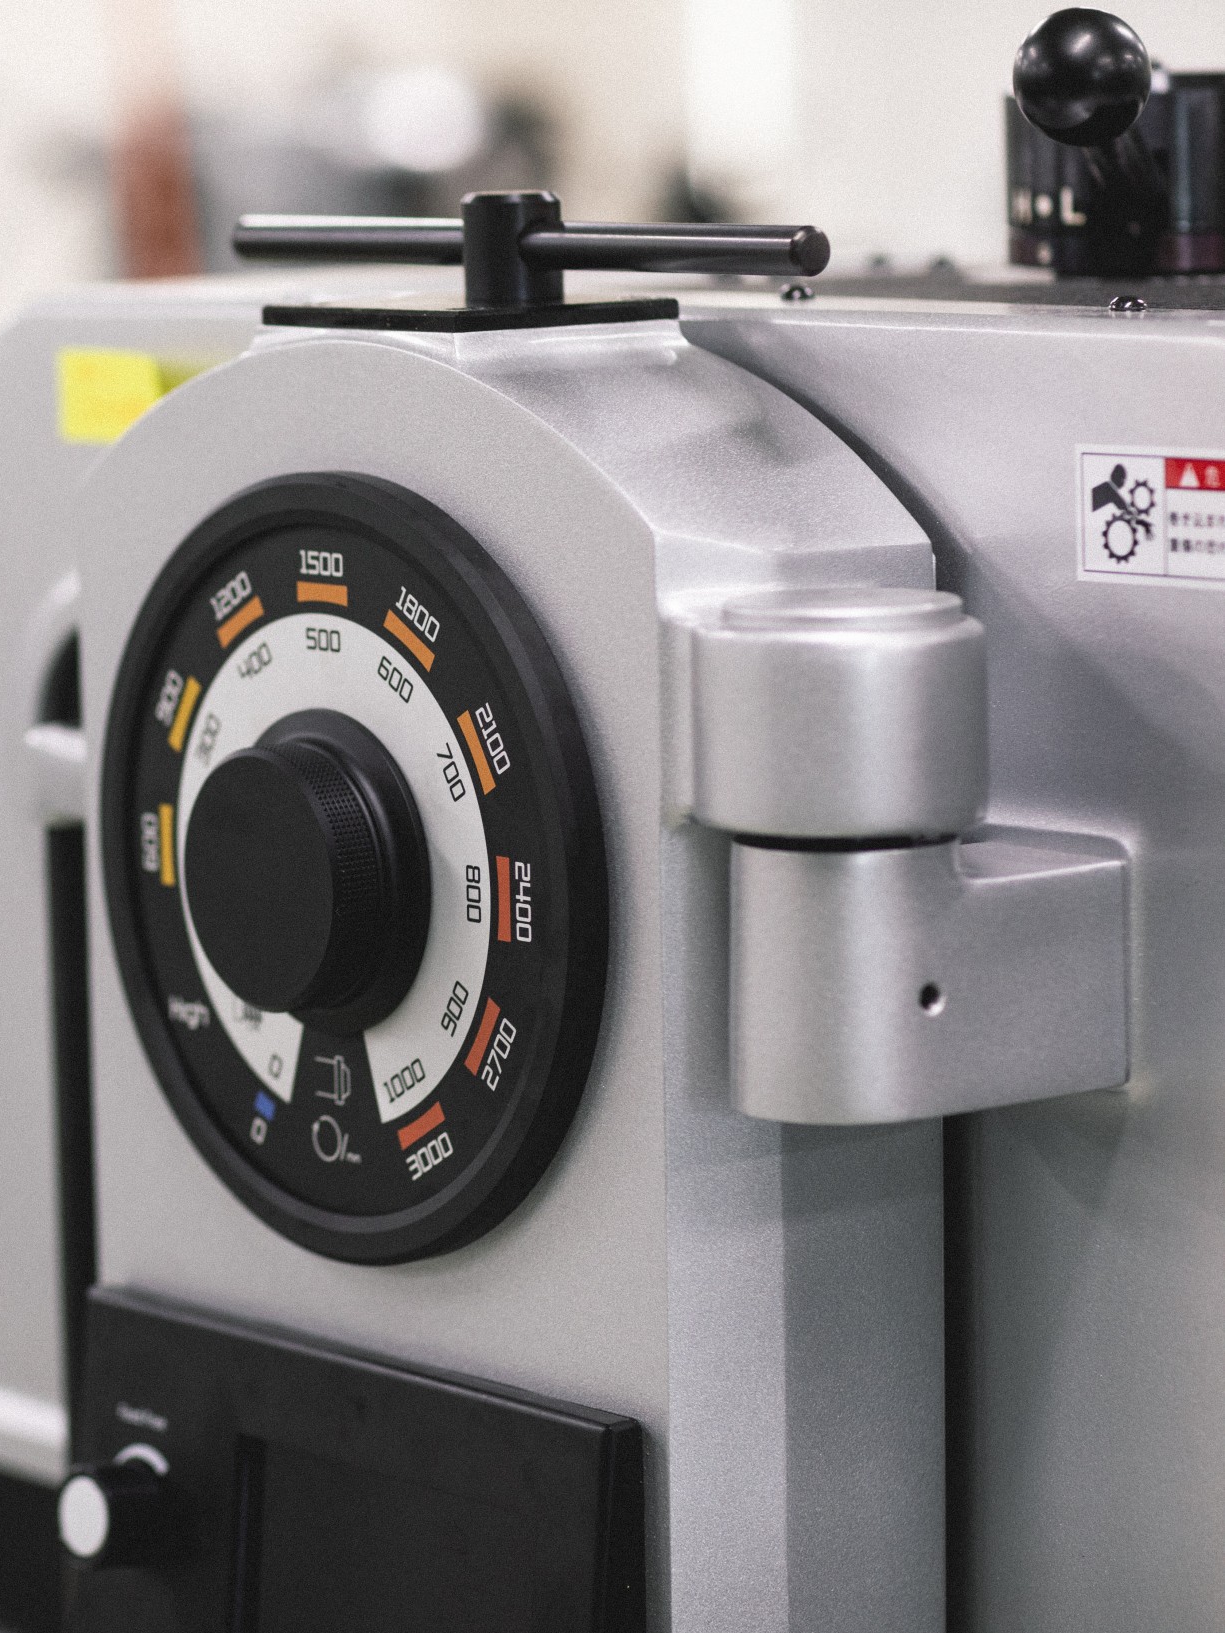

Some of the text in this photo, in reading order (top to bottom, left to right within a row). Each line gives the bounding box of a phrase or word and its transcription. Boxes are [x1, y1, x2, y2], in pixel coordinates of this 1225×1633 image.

[298, 549, 344, 578] 1500
[209, 570, 253, 622] 1200
[395, 585, 441, 643] 1800
[236, 641, 273, 680] 400
[305, 626, 342, 653] 500
[376, 655, 415, 704] 600
[475, 701, 511, 775] 2100
[436, 741, 467, 803] 700
[465, 864, 482, 924] 800
[514, 861, 533, 943] 2400
[440, 980, 469, 1038] 900
[267, 1052, 284, 1079] 0
[480, 1017, 518, 1092] 2700
[382, 1057, 427, 1104] 1000
[249, 1116, 268, 1146] 0
[405, 1131, 455, 1182] 3000
